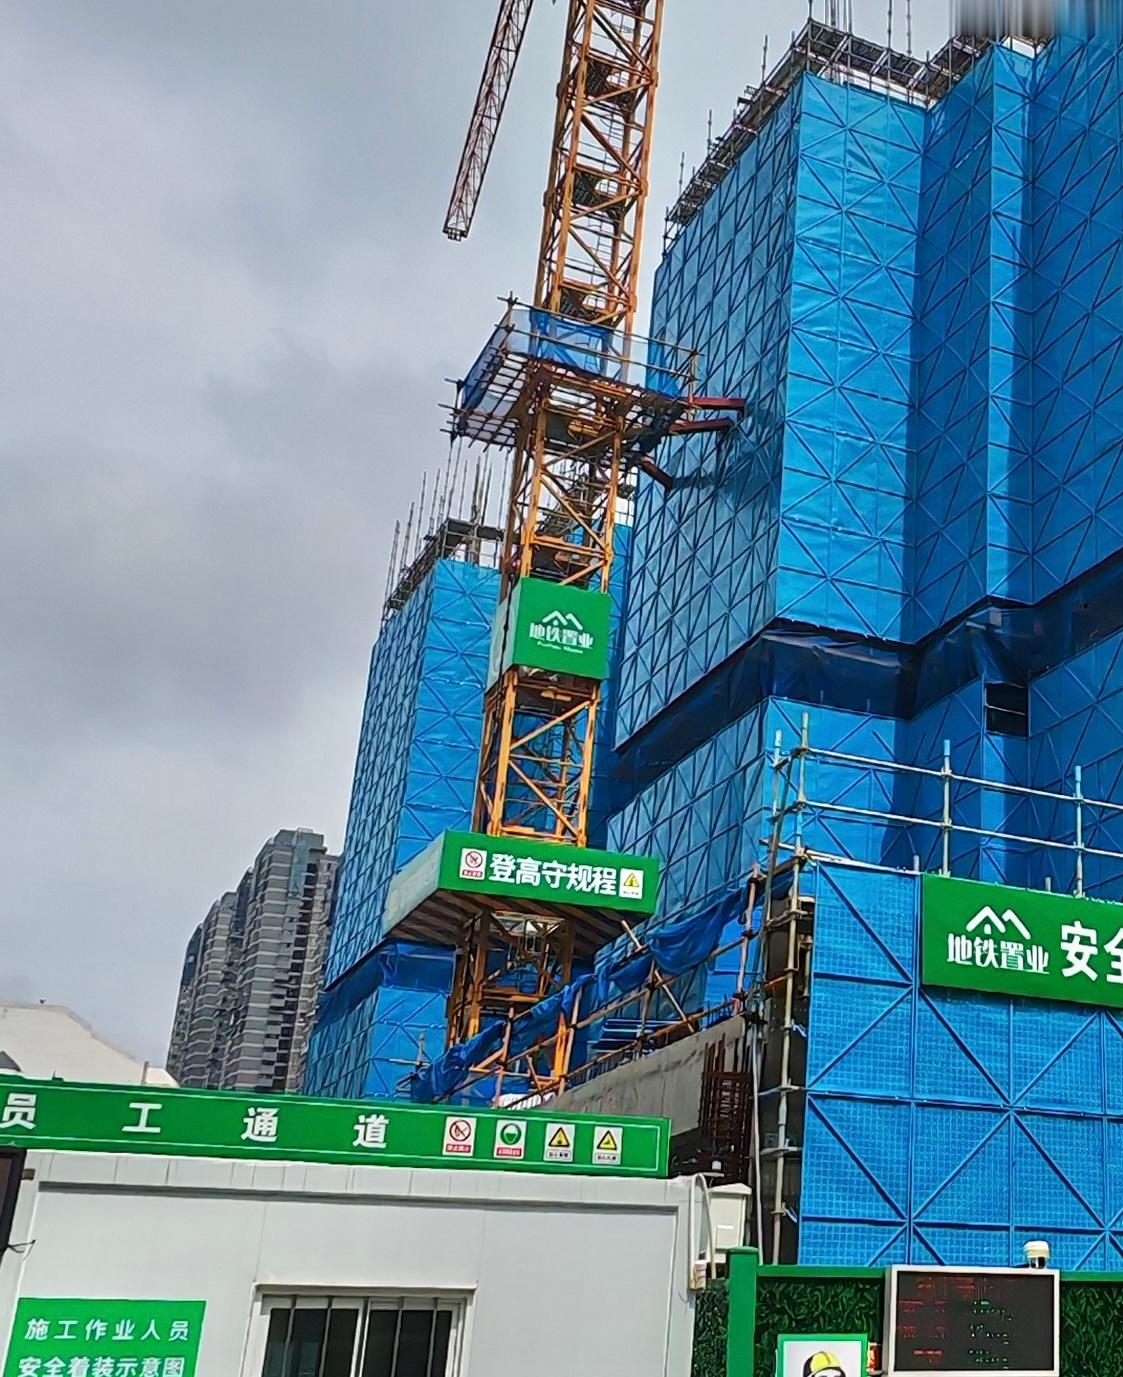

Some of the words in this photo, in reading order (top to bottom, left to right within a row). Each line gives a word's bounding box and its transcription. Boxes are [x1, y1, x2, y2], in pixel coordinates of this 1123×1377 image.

[529, 622, 594, 650] 地铁置业
[488, 853, 617, 896] 登高守规程
[947, 931, 1049, 975] 地铁置业
[24, 1318, 190, 1341] 施工作业人员
[18, 1356, 186, 1377] 安全着装示意图
